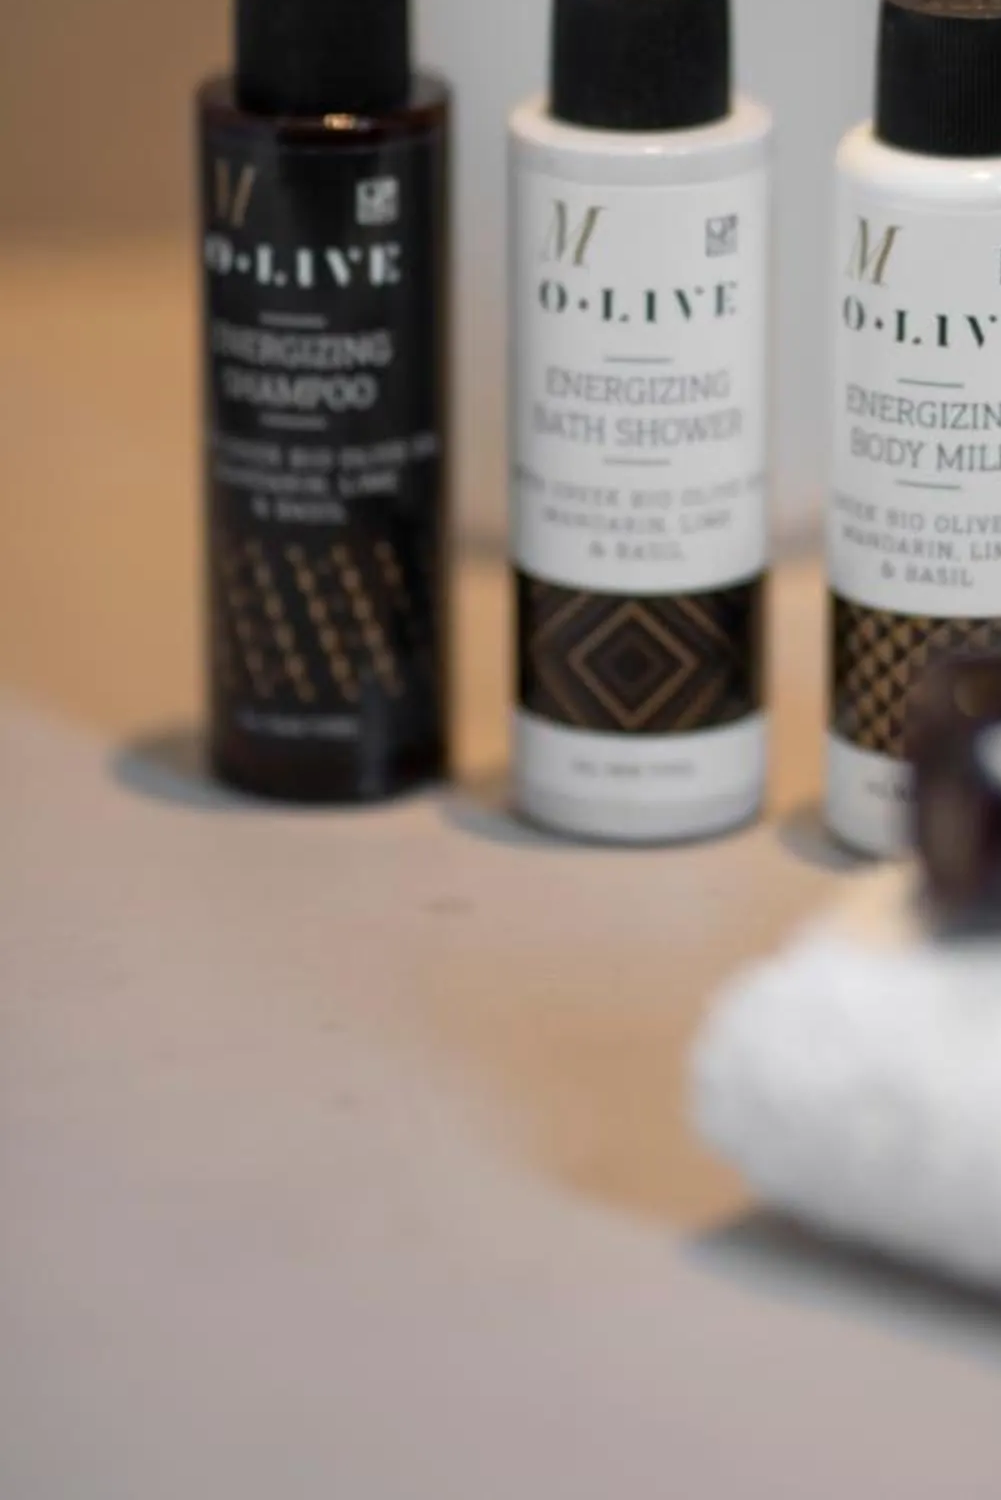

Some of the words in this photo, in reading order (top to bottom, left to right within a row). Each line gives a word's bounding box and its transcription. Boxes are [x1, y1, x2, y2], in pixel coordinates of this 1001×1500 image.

[541, 198, 608, 268] M
[845, 215, 904, 286] M
[545, 365, 732, 406] ENERGIZING
[532, 402, 607, 446] BATH
[615, 408, 742, 448] SHOWER
[850, 425, 925, 469] BODY
[885, 507, 925, 534] BIO
[880, 558, 897, 581] &
[904, 562, 975, 588] BASIL
